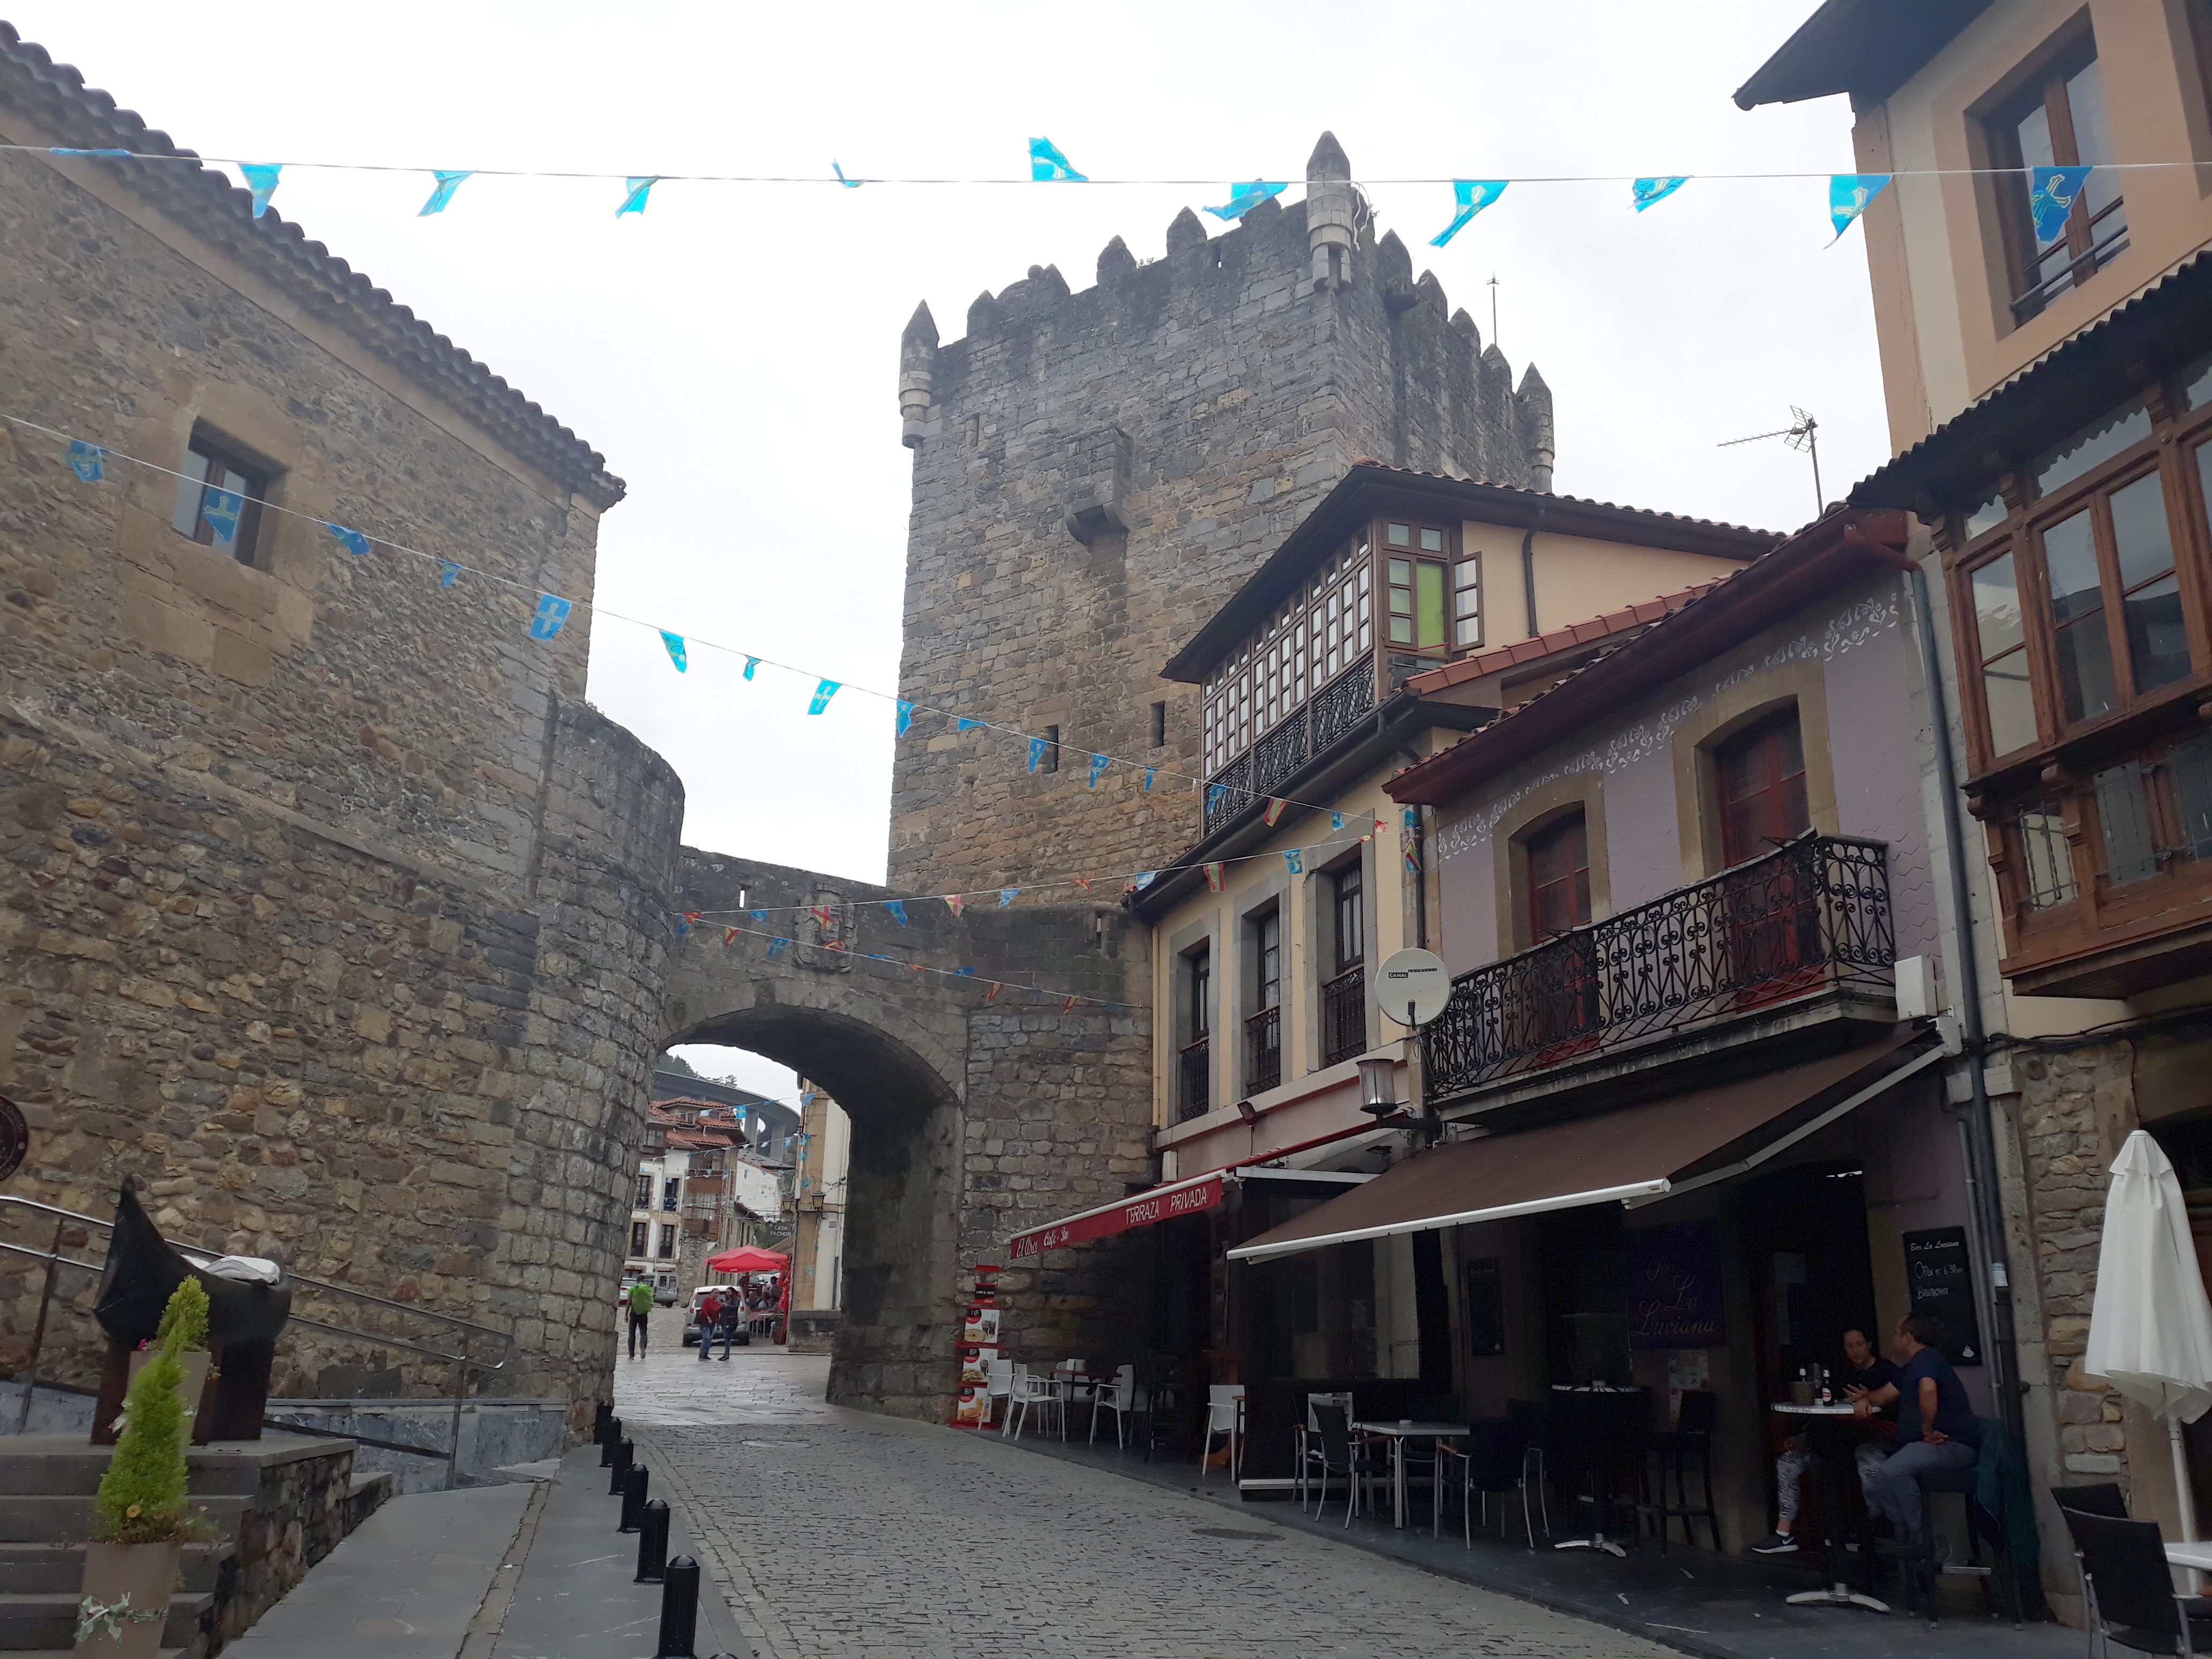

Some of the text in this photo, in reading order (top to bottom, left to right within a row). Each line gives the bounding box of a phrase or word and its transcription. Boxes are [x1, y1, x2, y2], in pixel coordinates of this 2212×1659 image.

[1126, 1187, 1207, 1225] TERRAZA PRIVADA
[1923, 1241, 1933, 1249] La
[1665, 1274, 1698, 1311] La
[1630, 1299, 1715, 1336] Luciana
